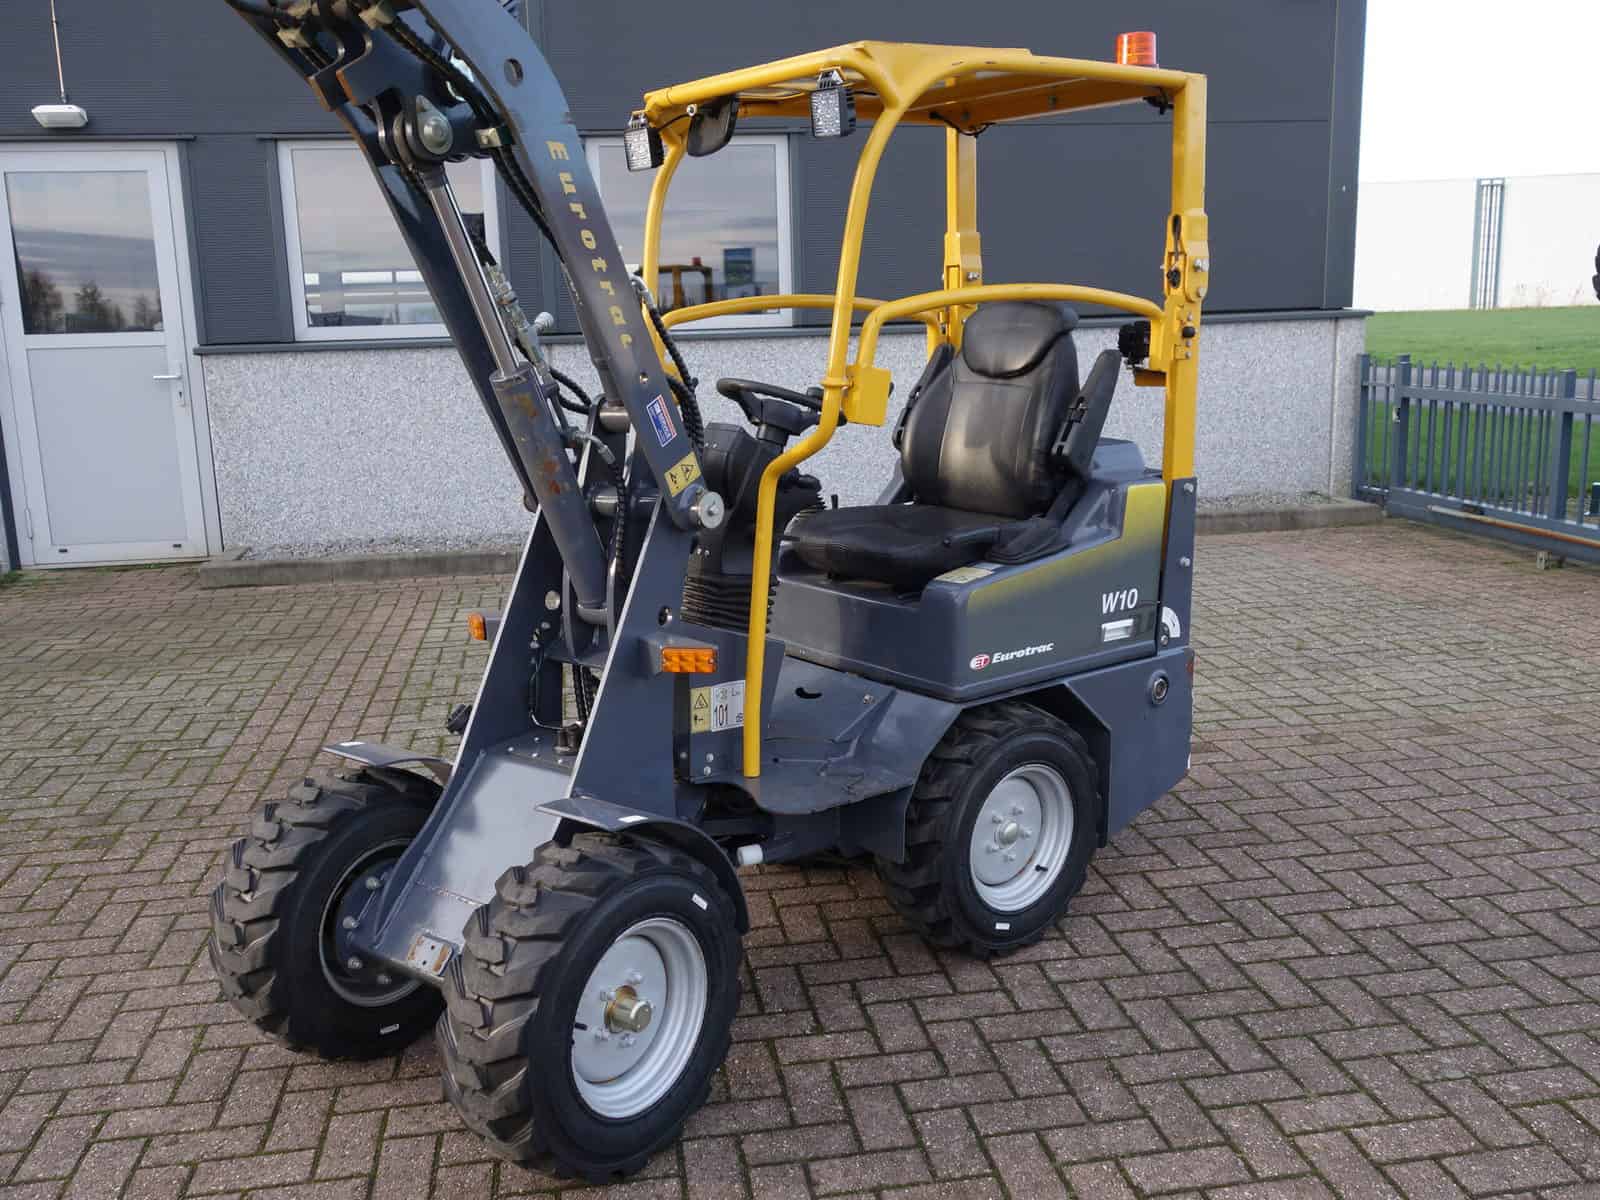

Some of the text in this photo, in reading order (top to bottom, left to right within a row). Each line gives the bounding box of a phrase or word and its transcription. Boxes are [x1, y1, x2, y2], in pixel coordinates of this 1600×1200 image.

[545, 140, 633, 348] Eurotrac
[1102, 588, 1138, 615] W10
[992, 642, 1055, 664] Eurotrac
[713, 704, 729, 728] 101
